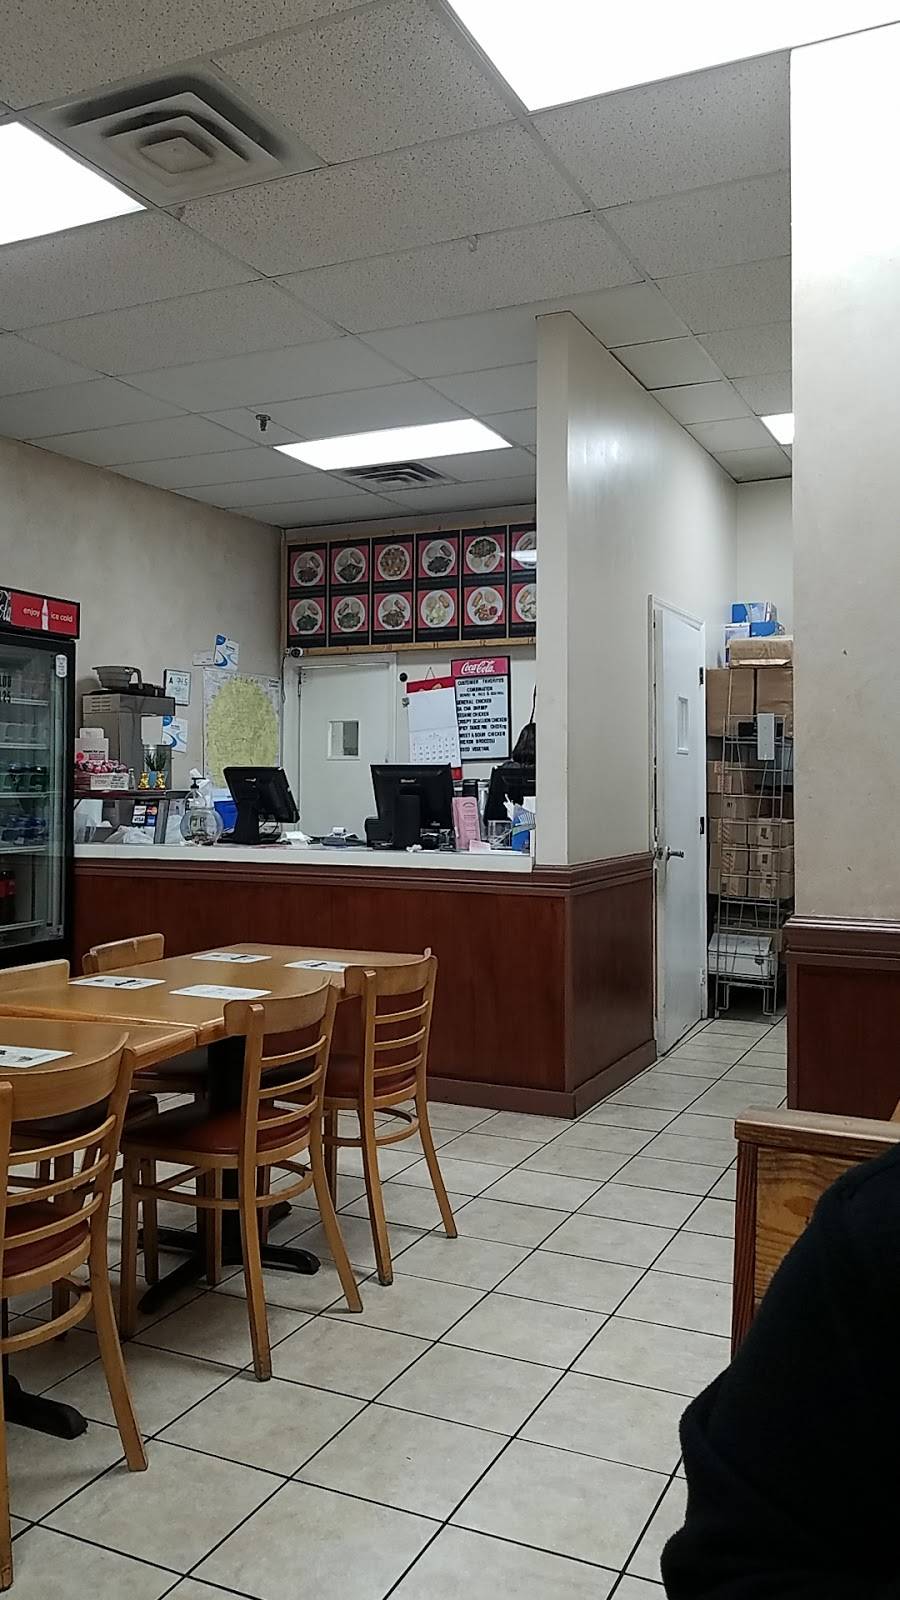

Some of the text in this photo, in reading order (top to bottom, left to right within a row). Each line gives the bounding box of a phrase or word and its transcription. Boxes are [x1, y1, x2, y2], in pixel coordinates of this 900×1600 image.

[23, 607, 73, 623] enjoy ice cold
[462, 660, 495, 674] Coca-Cola
